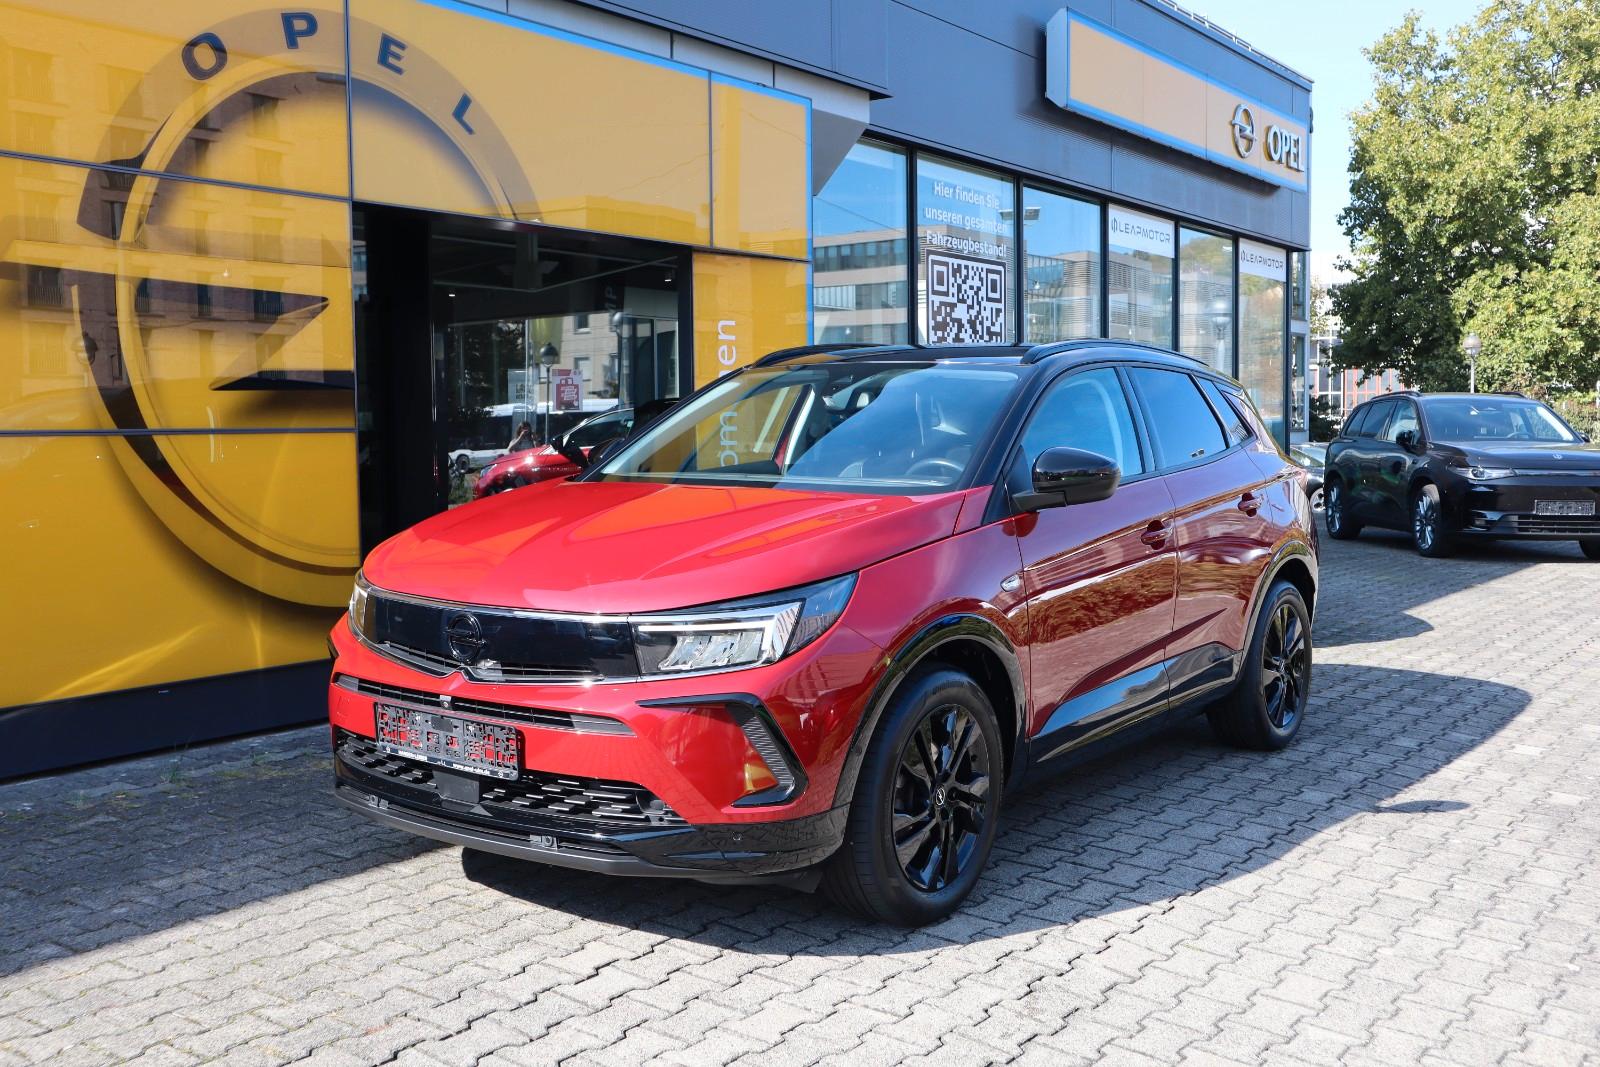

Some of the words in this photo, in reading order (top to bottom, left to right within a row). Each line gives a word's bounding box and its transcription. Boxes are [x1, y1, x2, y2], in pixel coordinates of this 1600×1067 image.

[181, 11, 477, 135] OPEL
[1265, 125, 1304, 171] OPEL
[934, 181, 953, 198] Hier
[955, 186, 984, 206] finden
[986, 194, 999, 209] Sie
[925, 207, 963, 225] unseren
[965, 215, 1007, 233] gesamten
[1118, 220, 1171, 243] LEAPMOTOR
[926, 230, 1007, 257] Fahrzeugbestand!
[1246, 254, 1284, 271] LEAPMOTOR
